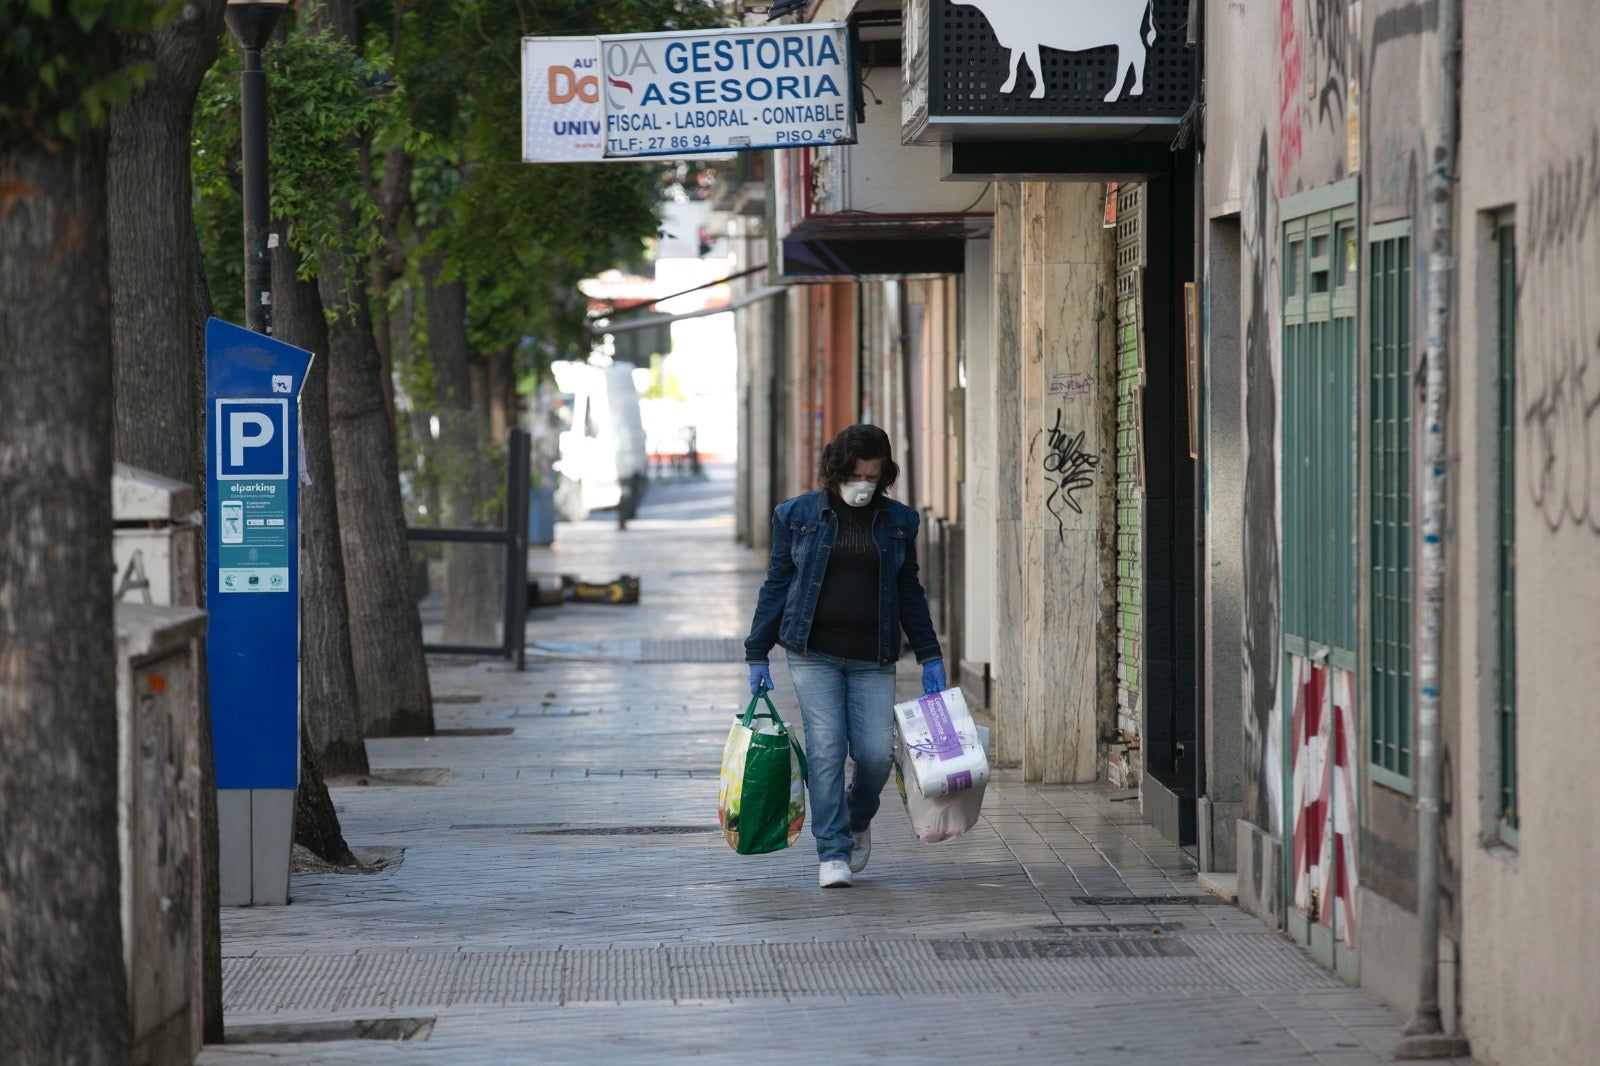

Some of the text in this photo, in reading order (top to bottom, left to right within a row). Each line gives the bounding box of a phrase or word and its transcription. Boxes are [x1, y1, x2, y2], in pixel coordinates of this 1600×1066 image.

[573, 58, 598, 69] AU
[665, 35, 841, 74] GESTORIA
[640, 74, 841, 107] ASESORIA
[607, 113, 661, 132] FISCAL
[675, 109, 749, 129] LABORAL
[762, 103, 845, 125] CONTABLE
[607, 134, 711, 151] TLF: 27 86 94
[776, 130, 813, 142] PISO
[230, 412, 275, 466] P
[230, 483, 276, 494] elparking
